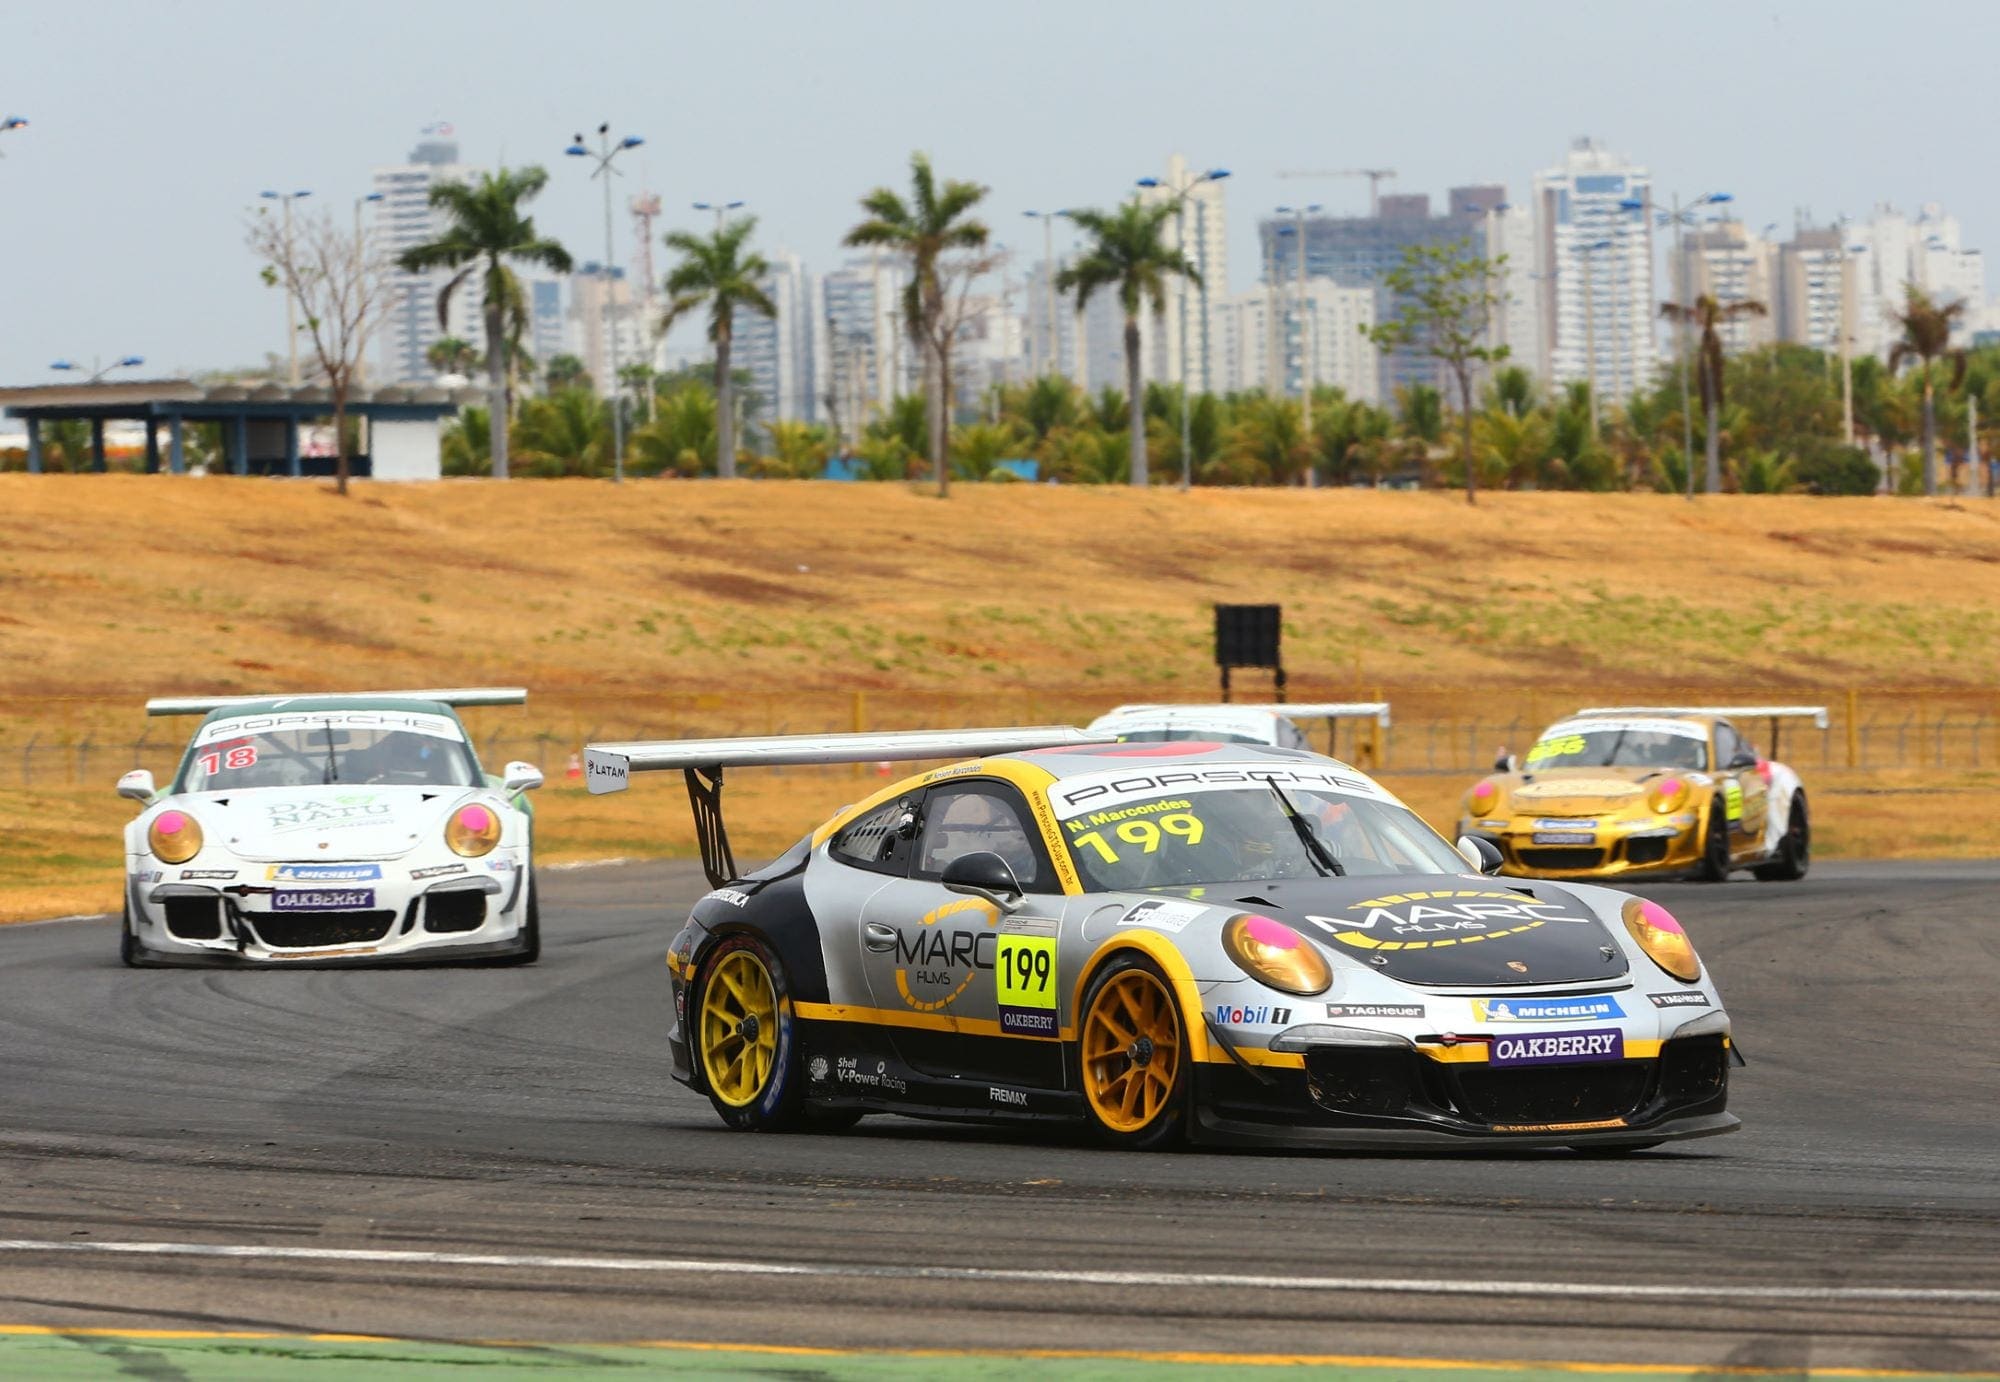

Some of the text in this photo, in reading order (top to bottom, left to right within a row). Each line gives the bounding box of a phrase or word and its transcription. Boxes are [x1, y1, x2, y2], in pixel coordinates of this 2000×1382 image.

[210, 715, 446, 737] PORSCHE
[198, 745, 258, 776] 18
[595, 764, 626, 779] LATAM
[1062, 770, 1375, 806] PORSCHE
[267, 800, 331, 815] DA
[271, 804, 392, 828] NATU
[1066, 800, 1192, 833] N. Marcondes
[1073, 813, 1204, 864] 199
[275, 890, 371, 907] OAKBERRY
[1304, 903, 1590, 933] MARC
[1392, 921, 1487, 934] FILMS
[896, 927, 997, 969] MARC
[916, 971, 950, 985] FILMS
[1001, 947, 1050, 992] 199
[1004, 1012, 1053, 1030] OAKBERRY
[1215, 1006, 1268, 1024] Mobil
[1518, 1003, 1610, 1017] MICHELIN
[1496, 1034, 1617, 1060] OAKBERRY
[837, 1057, 857, 1068] Shell
[837, 1069, 907, 1094] V-Power Racing
[990, 1087, 1028, 1106] FREMAX
